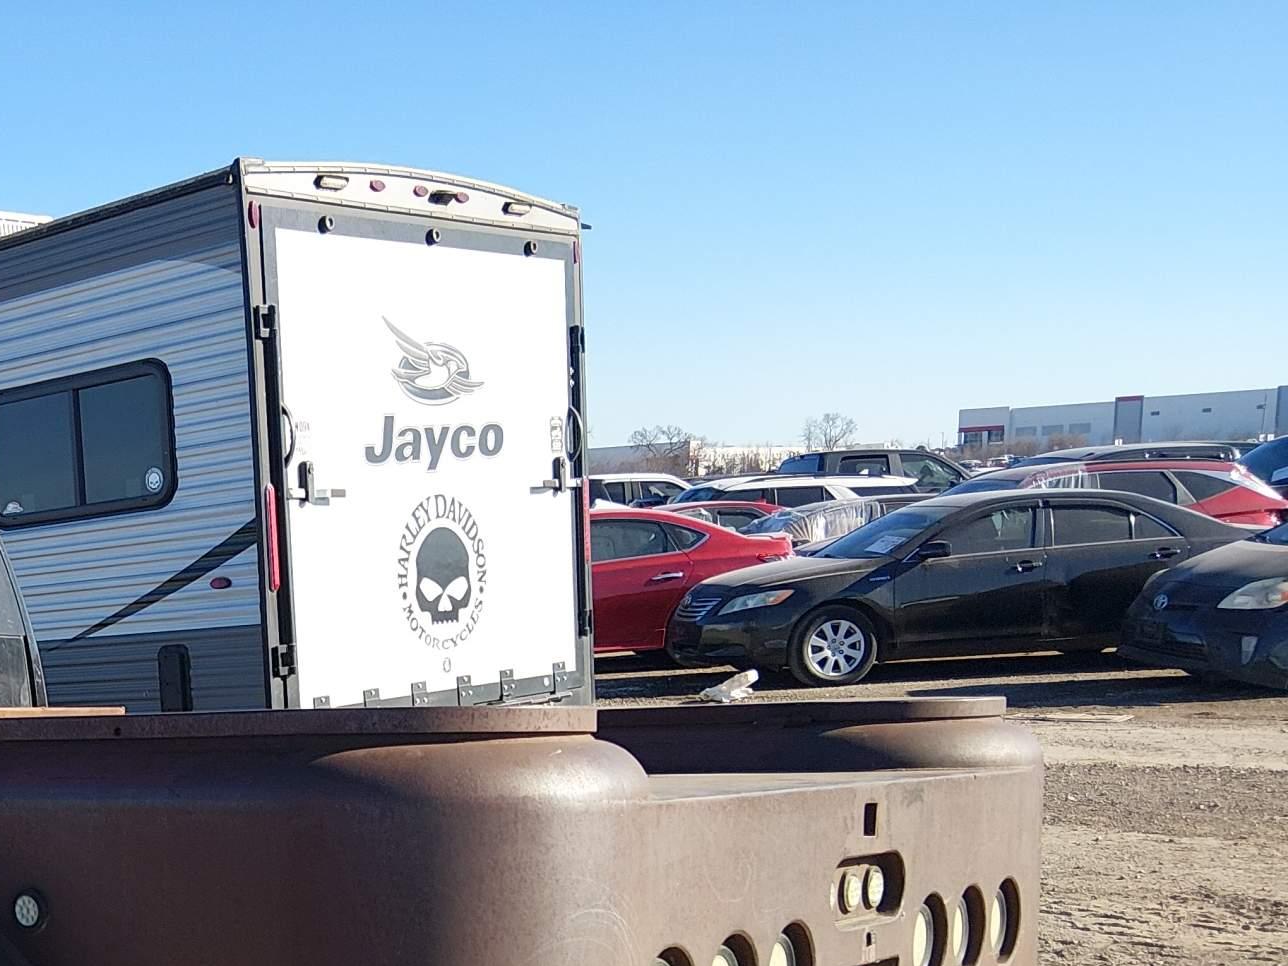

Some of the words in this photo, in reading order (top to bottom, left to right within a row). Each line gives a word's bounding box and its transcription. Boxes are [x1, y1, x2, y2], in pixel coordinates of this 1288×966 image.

[364, 415, 504, 471] Jayco
[397, 496, 431, 589] HARLEY
[434, 494, 487, 585] DAVIDSON
[402, 598, 484, 651] MOTORCYCLES
